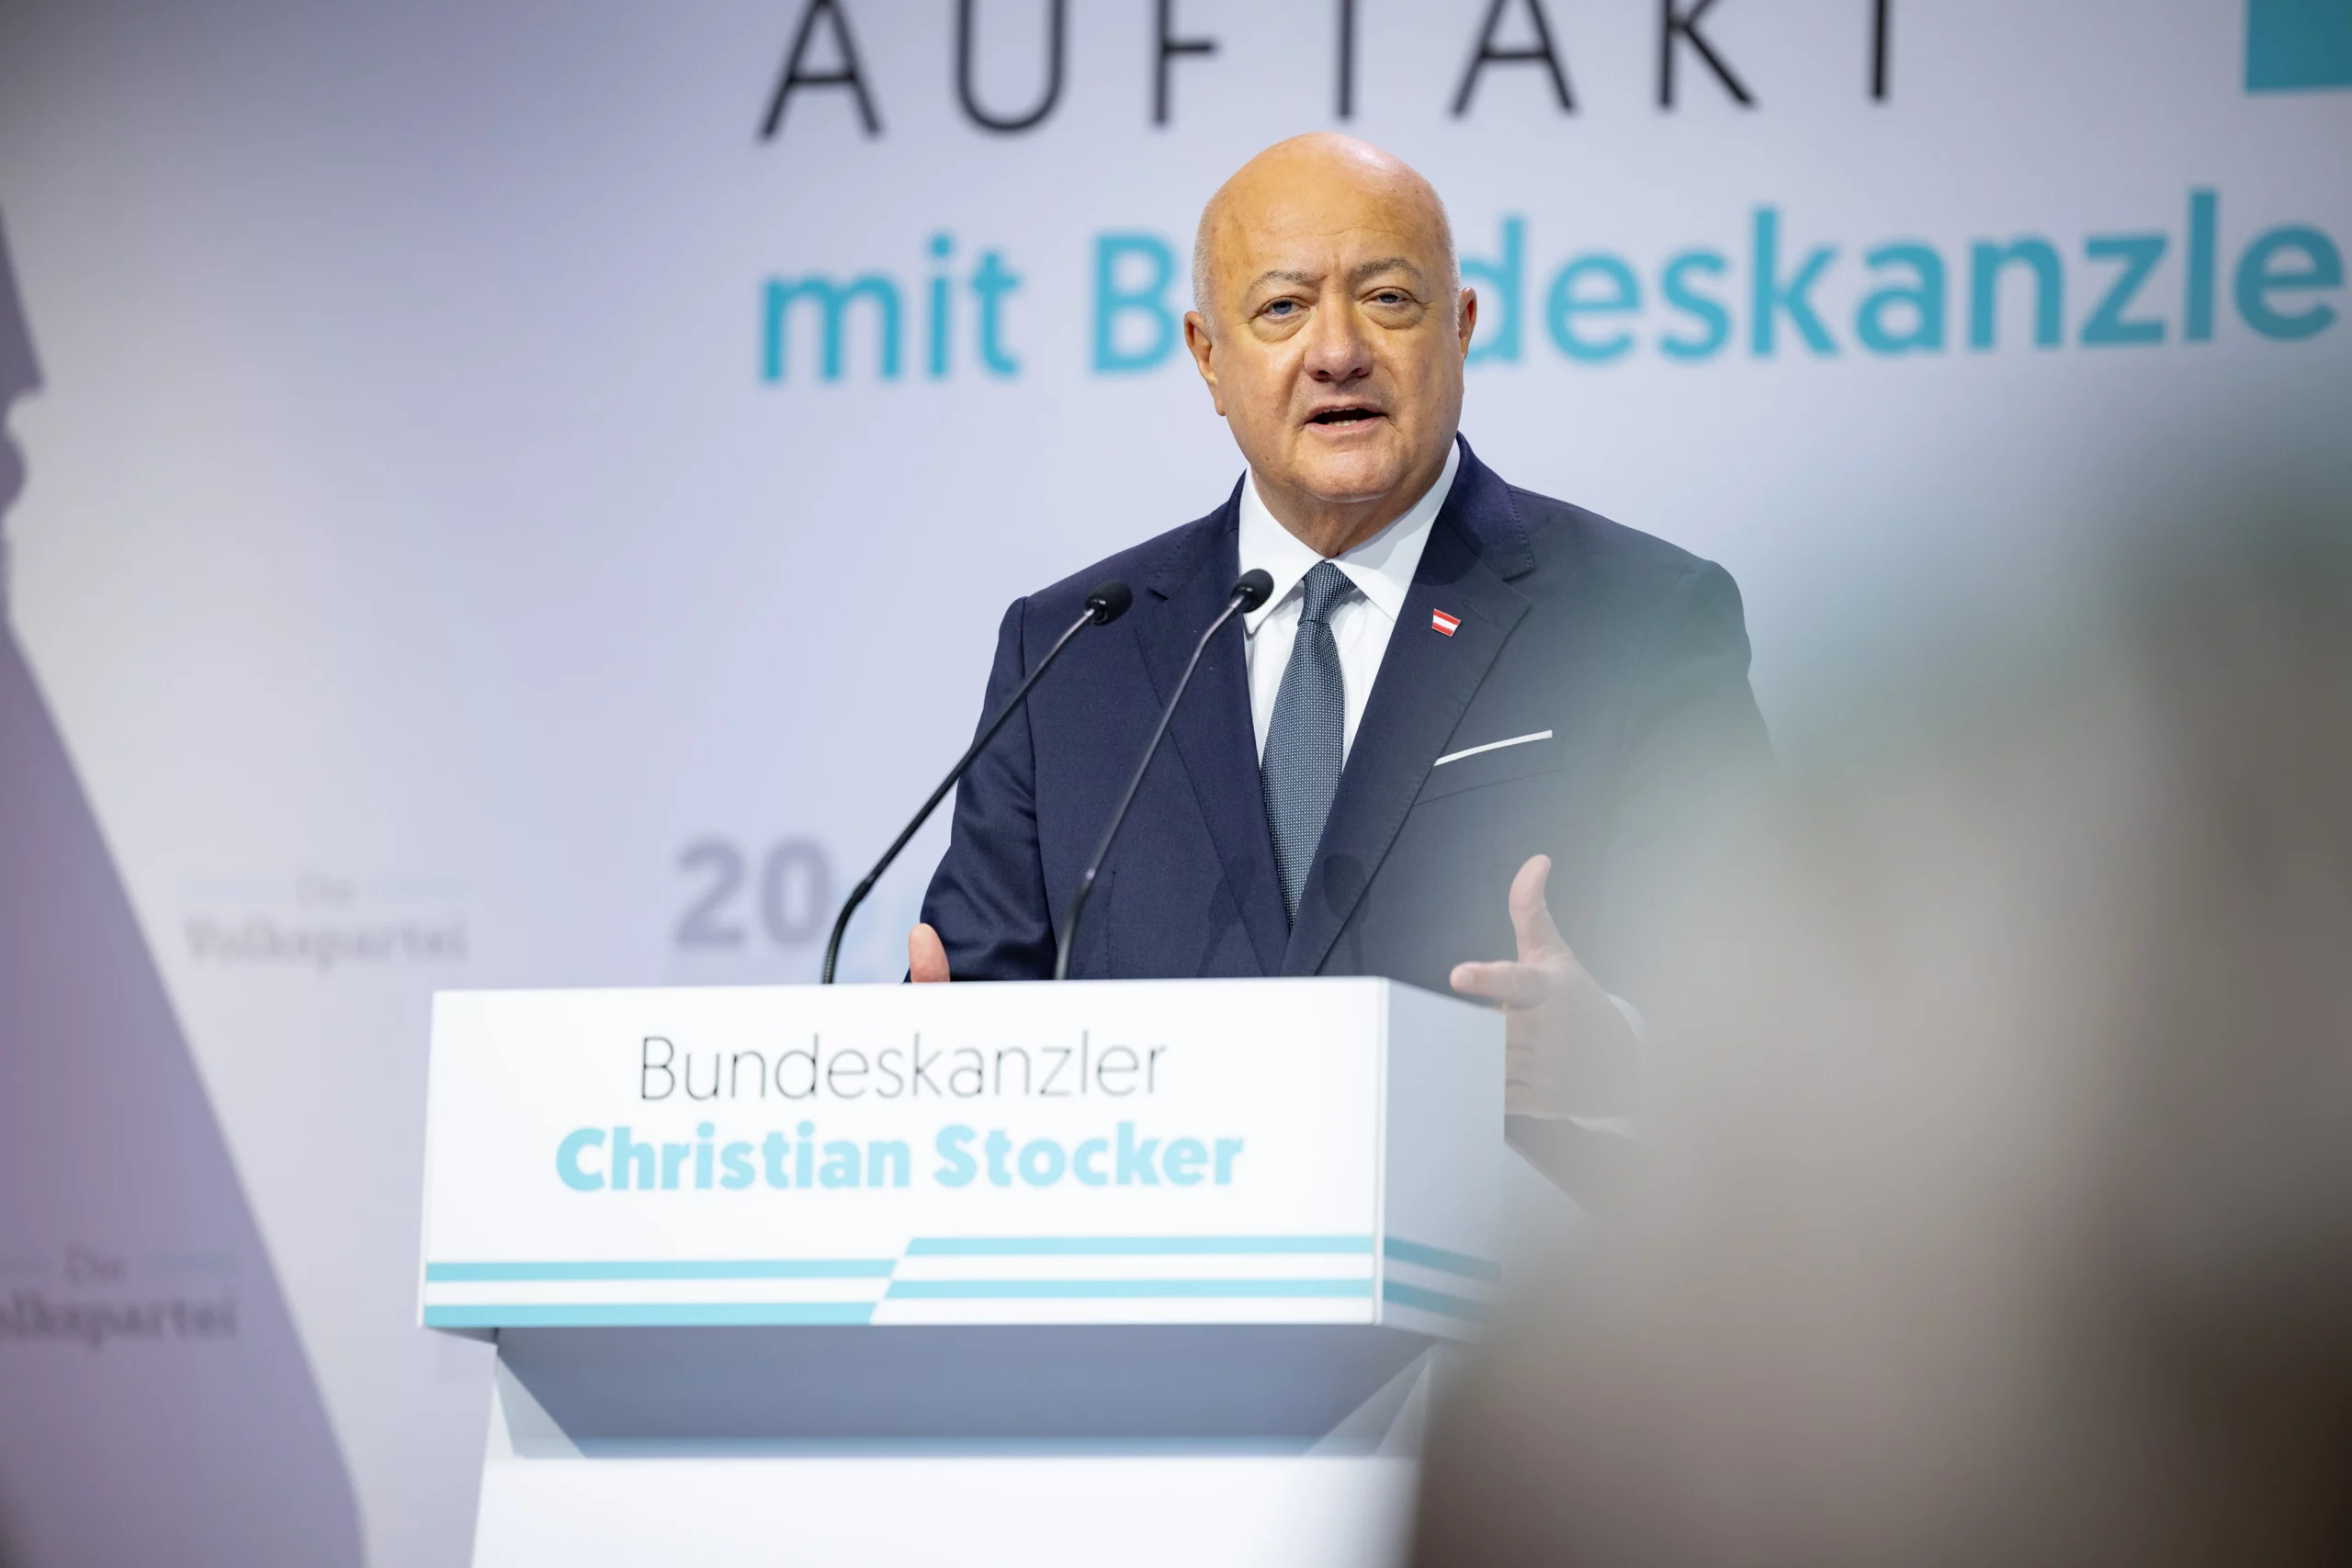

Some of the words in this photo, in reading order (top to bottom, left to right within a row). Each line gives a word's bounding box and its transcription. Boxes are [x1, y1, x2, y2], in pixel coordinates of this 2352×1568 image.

[761, 231, 1020, 382] mit
[1091, 189, 2346, 378] Bdeskanzle
[676, 836, 829, 950] 20
[641, 1031, 1169, 1102] Bundeskanzler
[556, 1121, 911, 1192] Christian
[933, 1121, 1246, 1190] Stocker
